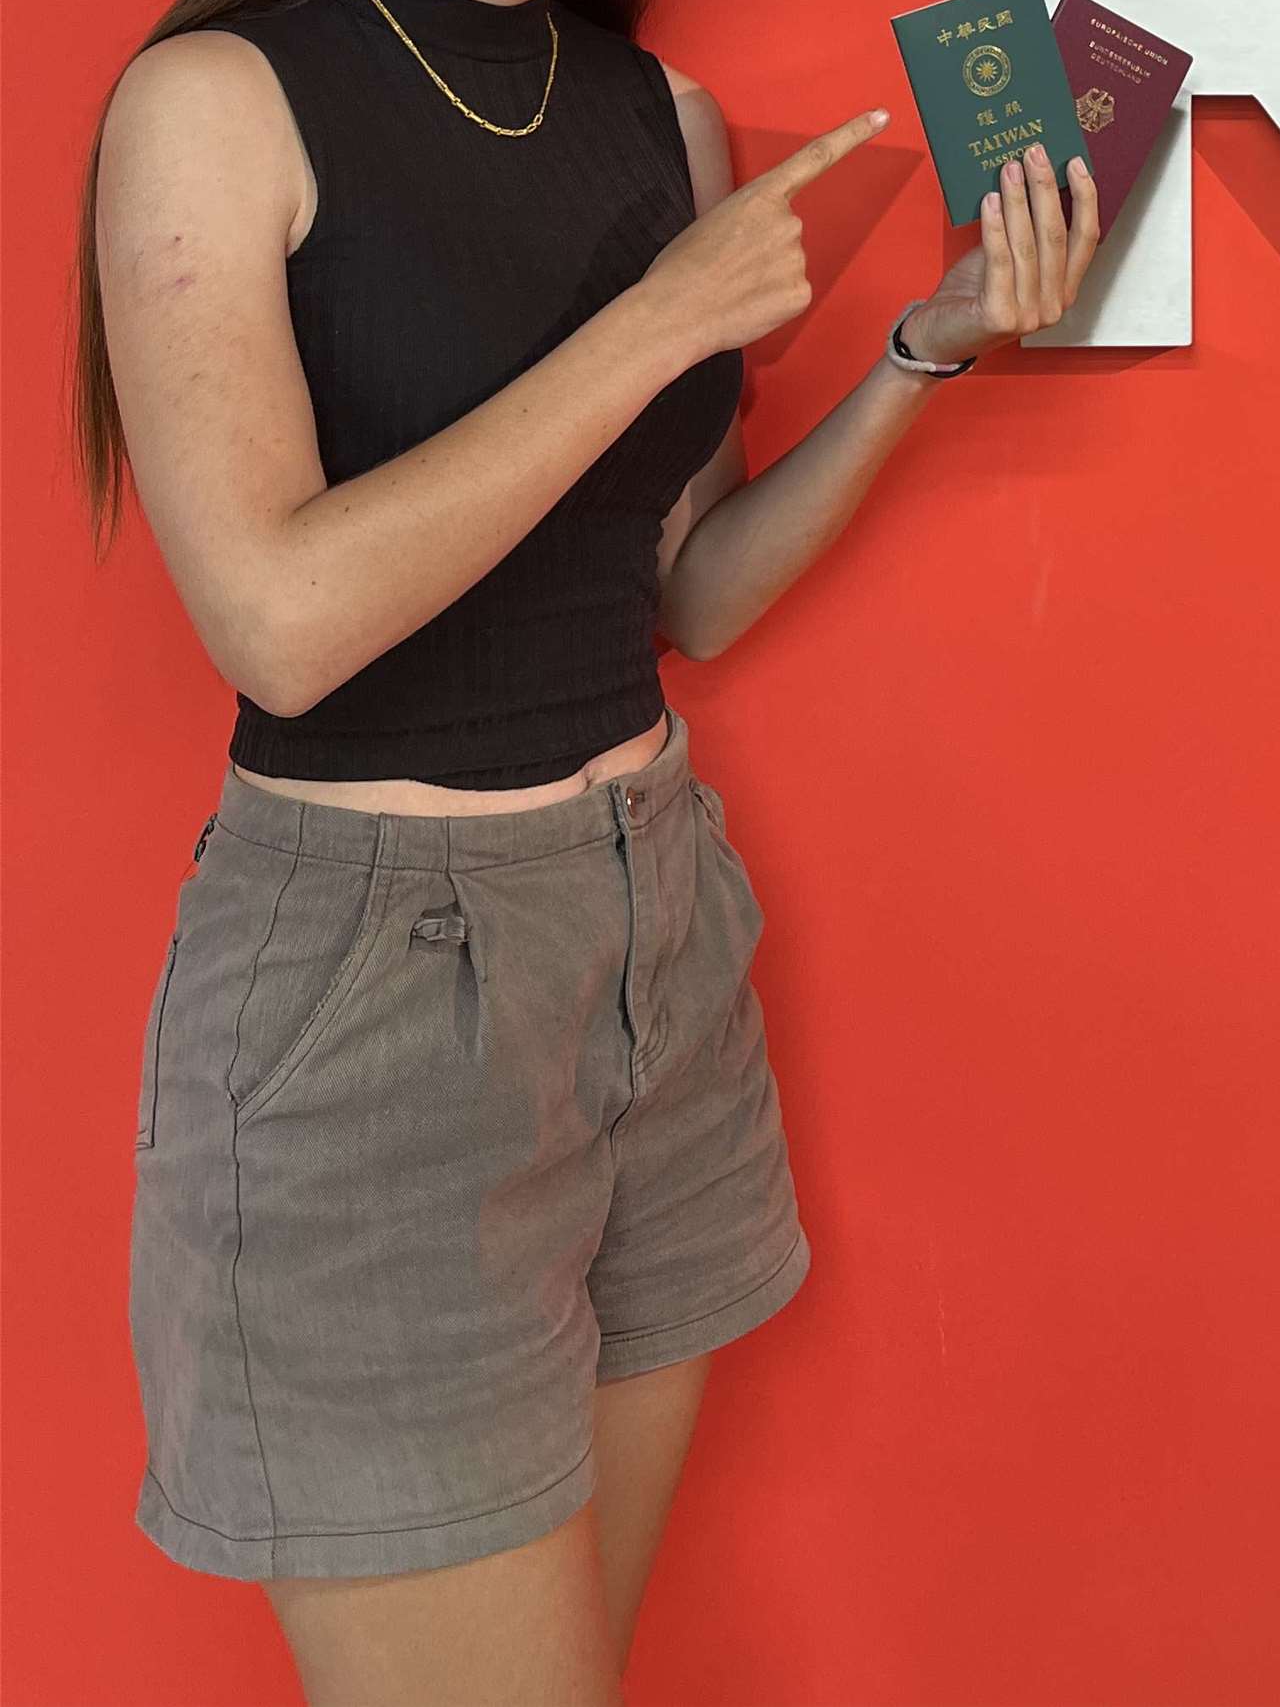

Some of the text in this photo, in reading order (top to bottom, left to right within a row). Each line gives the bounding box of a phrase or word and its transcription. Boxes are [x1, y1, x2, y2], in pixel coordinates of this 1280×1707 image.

[936, 9, 1014, 47] 中華民國
[1144, 48, 1169, 66] UNION
[968, 118, 1043, 157] TAIWAN
[981, 141, 1040, 171] PASSPO
